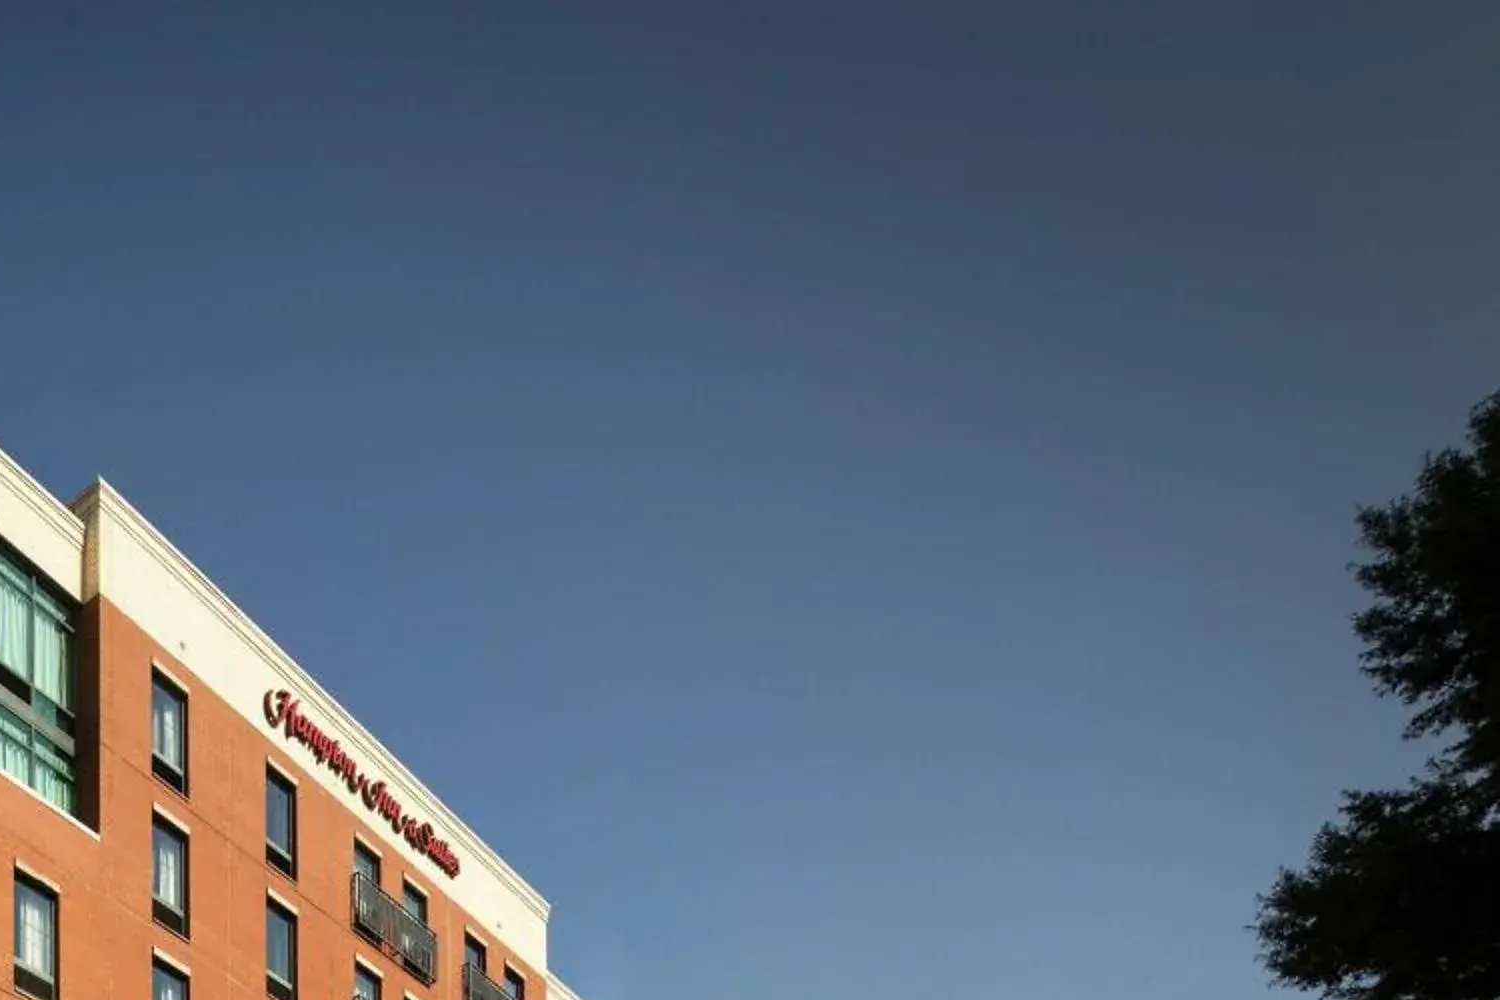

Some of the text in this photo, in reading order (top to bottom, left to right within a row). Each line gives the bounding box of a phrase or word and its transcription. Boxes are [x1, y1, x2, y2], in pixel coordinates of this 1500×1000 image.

[263, 689, 363, 793] Hampton
[360, 774, 408, 834] Inn
[417, 821, 461, 880] Suites
